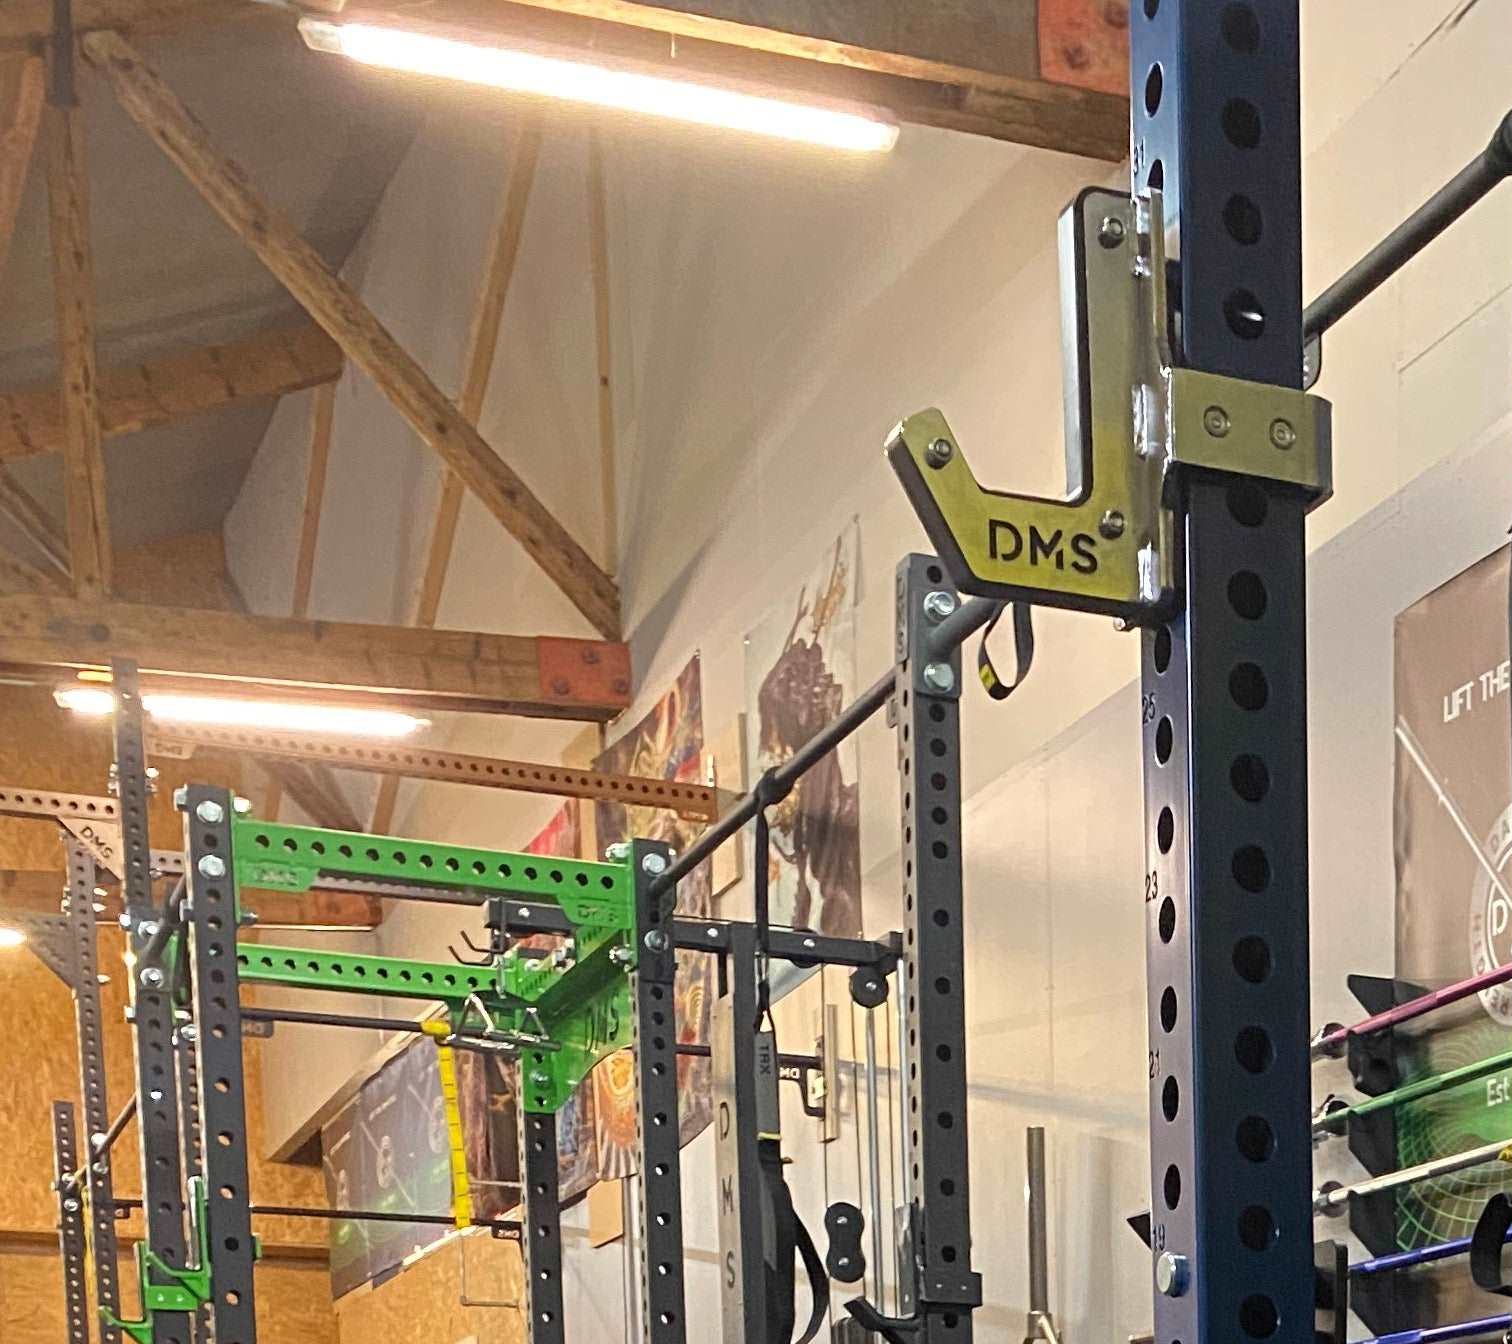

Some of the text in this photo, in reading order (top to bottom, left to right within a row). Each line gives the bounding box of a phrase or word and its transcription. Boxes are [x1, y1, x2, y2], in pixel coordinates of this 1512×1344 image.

[989, 518, 1099, 575] DMS
[1141, 692, 1156, 724] 25
[1443, 681, 1475, 723] LIFT
[1479, 660, 1511, 702] THE
[80, 826, 114, 859] DMS
[1145, 870, 1159, 903] 23
[758, 1045, 772, 1075] TRX
[1148, 1050, 1162, 1081] 21
[1487, 1077, 1510, 1107] Est
[718, 1101, 738, 1290] DMS
